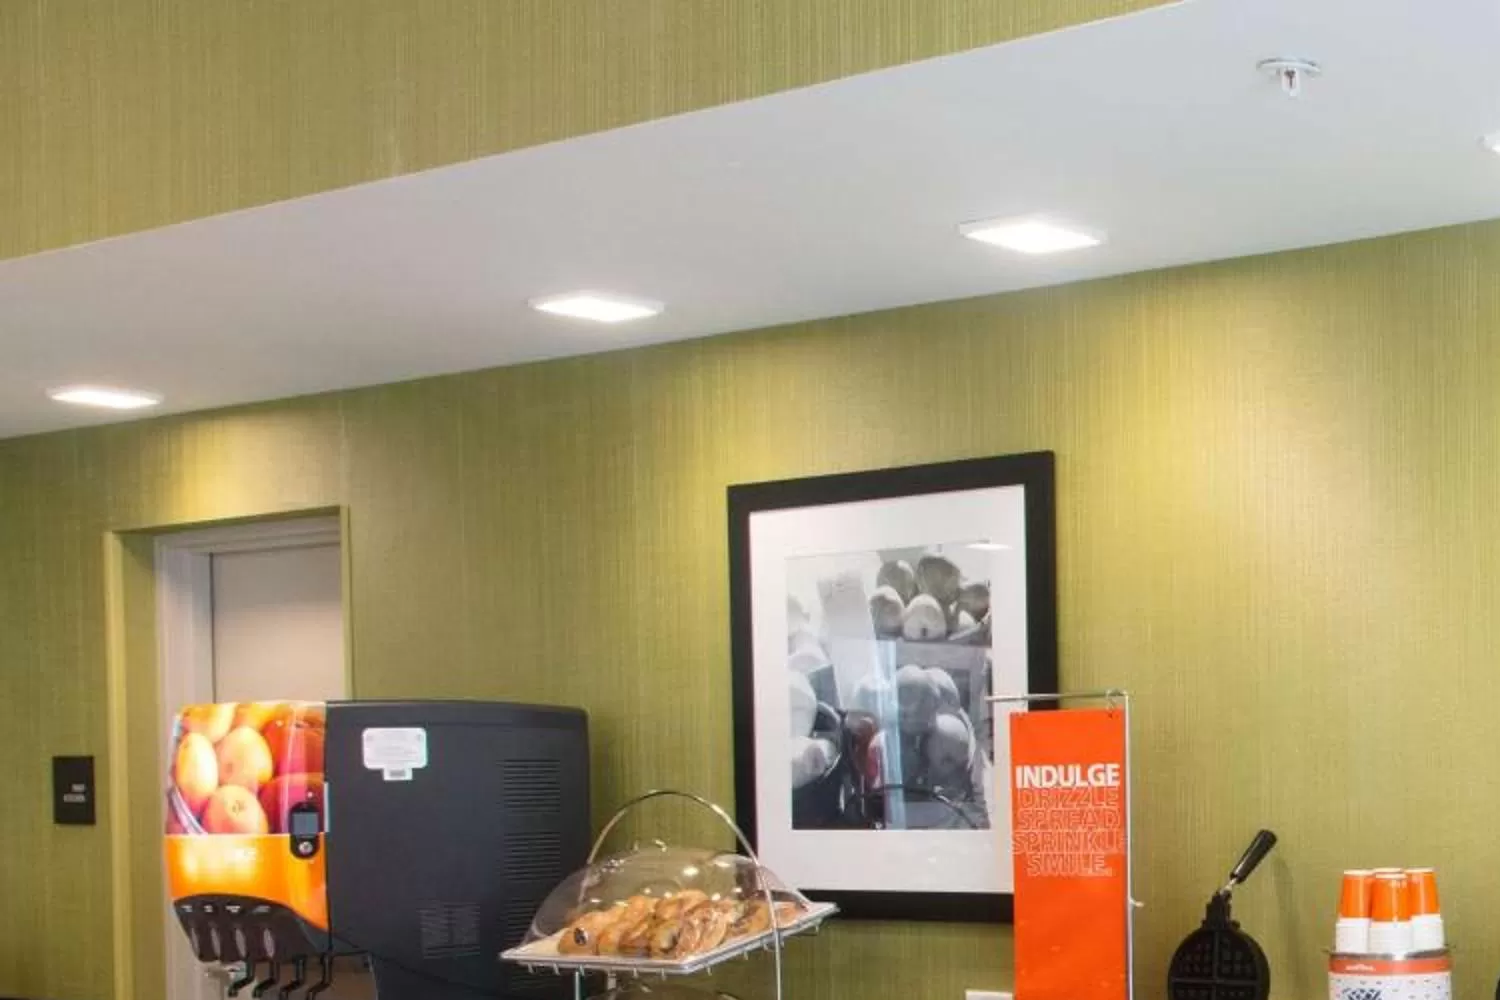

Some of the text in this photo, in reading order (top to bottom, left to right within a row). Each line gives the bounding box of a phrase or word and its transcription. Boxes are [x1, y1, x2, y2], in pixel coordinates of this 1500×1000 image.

[1015, 763, 1121, 788] INDULGE
[1018, 786, 1119, 808] DRIZZLE
[1018, 808, 1122, 831] SPREAD
